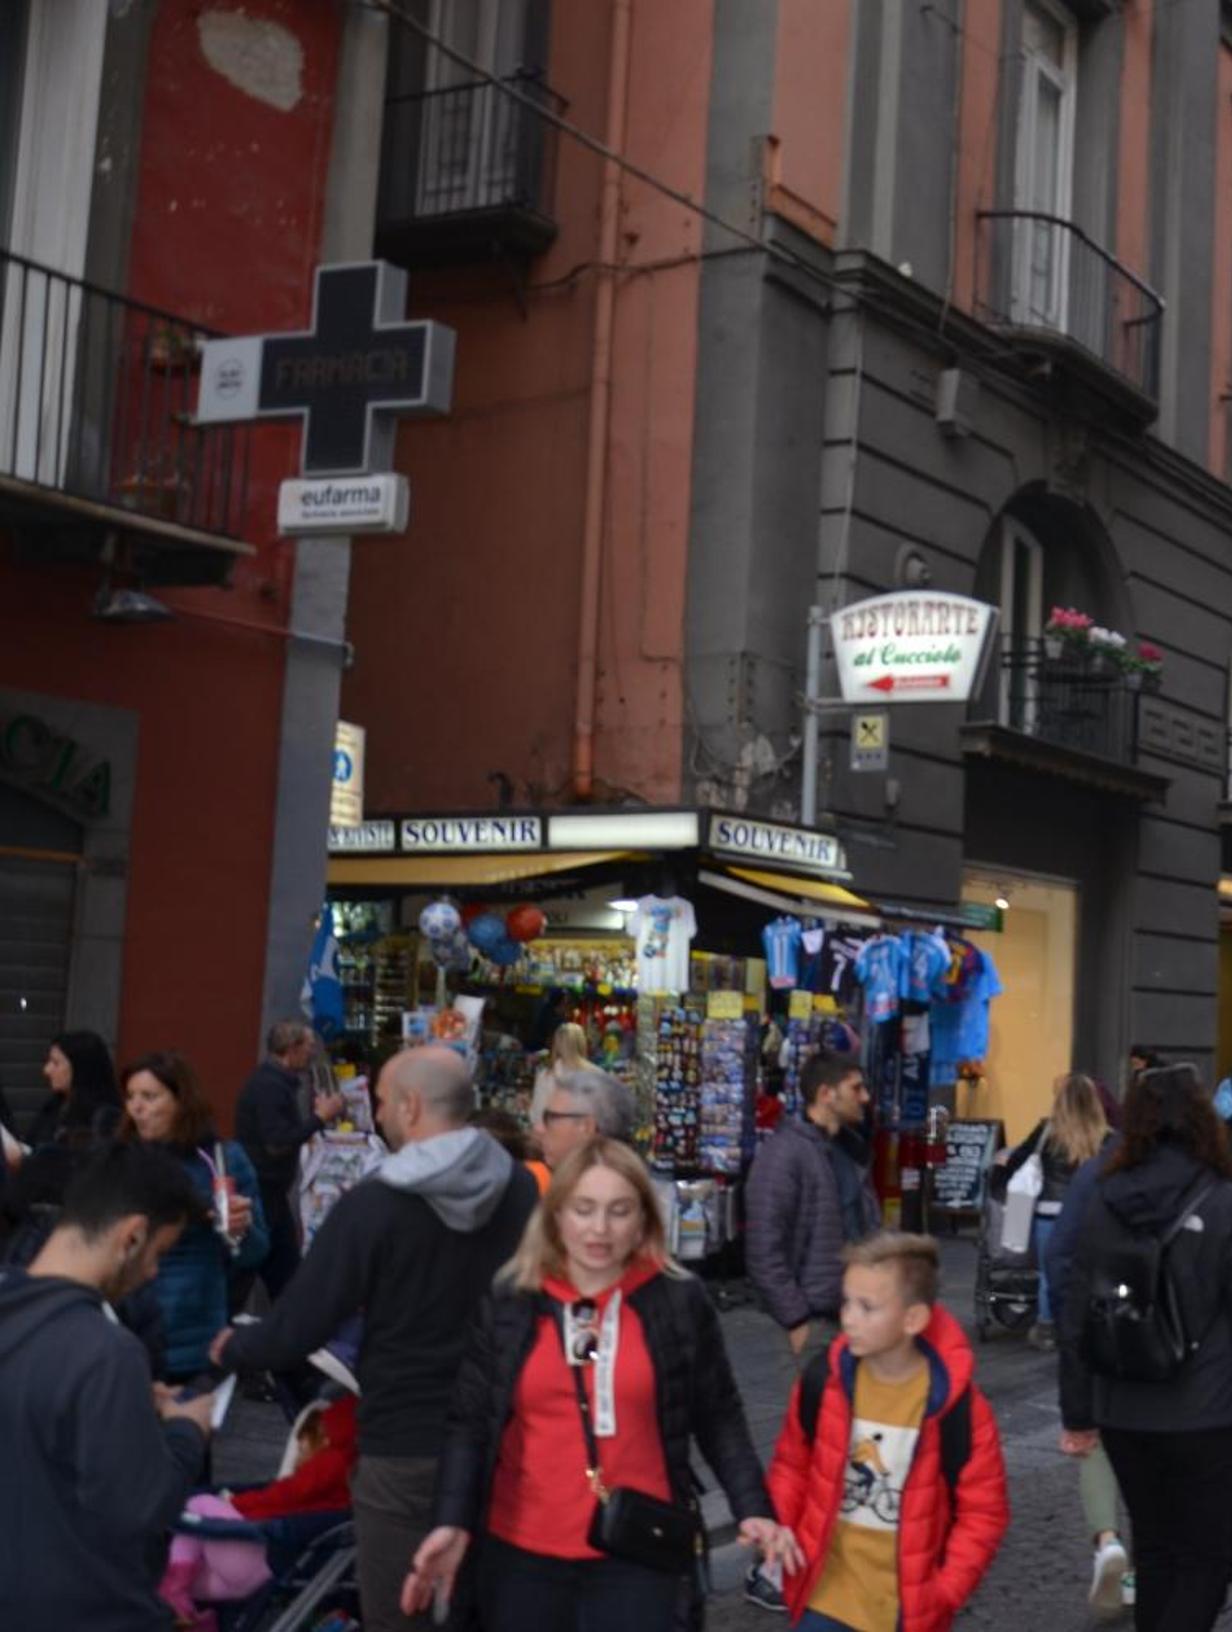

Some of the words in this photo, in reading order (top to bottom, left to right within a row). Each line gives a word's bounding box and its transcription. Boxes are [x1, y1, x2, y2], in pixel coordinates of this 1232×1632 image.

[880, 642, 962, 667] Cucciolo
[405, 819, 537, 845] SOUVENIR
[717, 819, 832, 861] SOUVENIR
